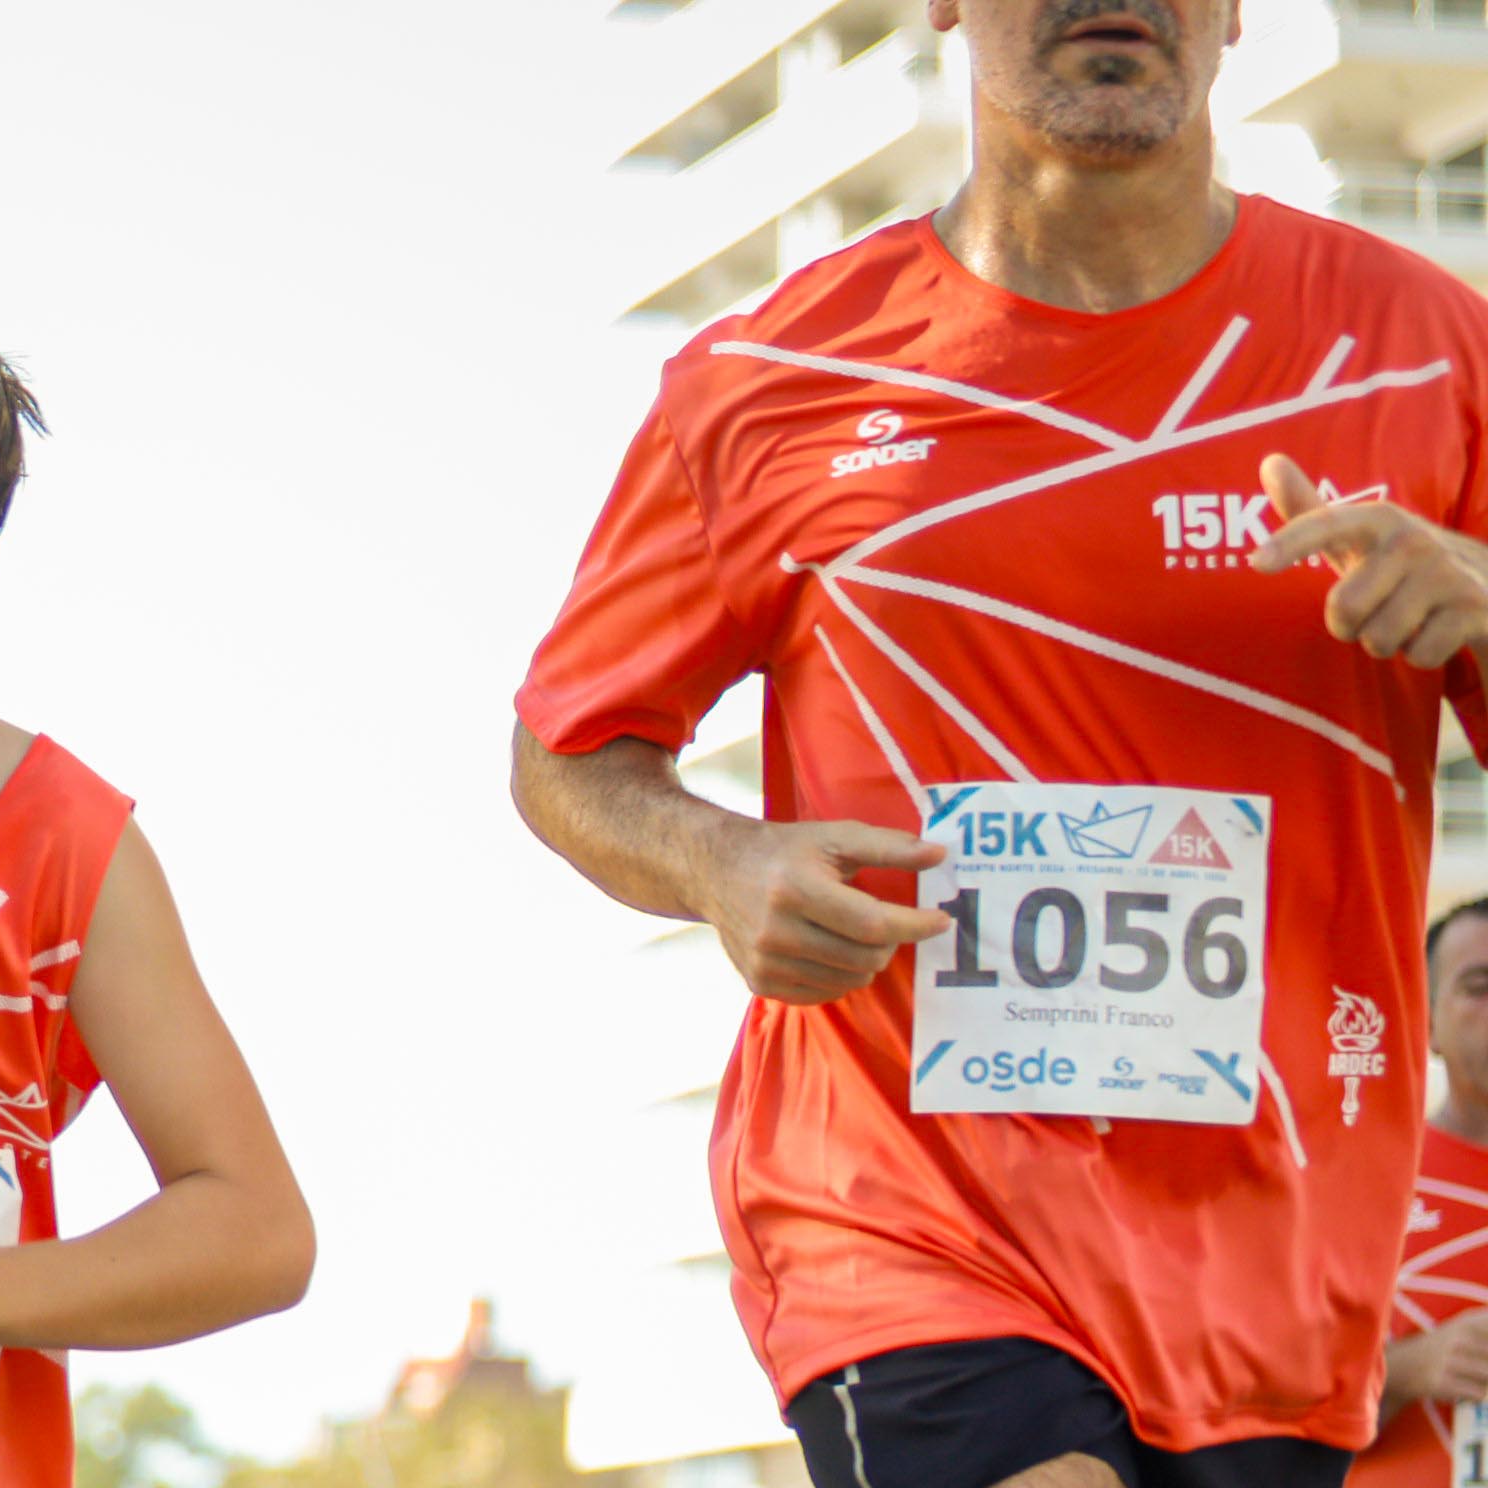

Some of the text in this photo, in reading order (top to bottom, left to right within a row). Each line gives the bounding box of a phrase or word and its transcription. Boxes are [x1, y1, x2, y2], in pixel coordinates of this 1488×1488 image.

[1151, 494, 1272, 550] 15K
[1164, 554, 1258, 569] PUERT
[957, 811, 1215, 861] 15K 15K
[935, 887, 1248, 1000] 1056
[1004, 1002, 1175, 1028] Semprini Franco
[962, 1046, 1077, 1092] osde
